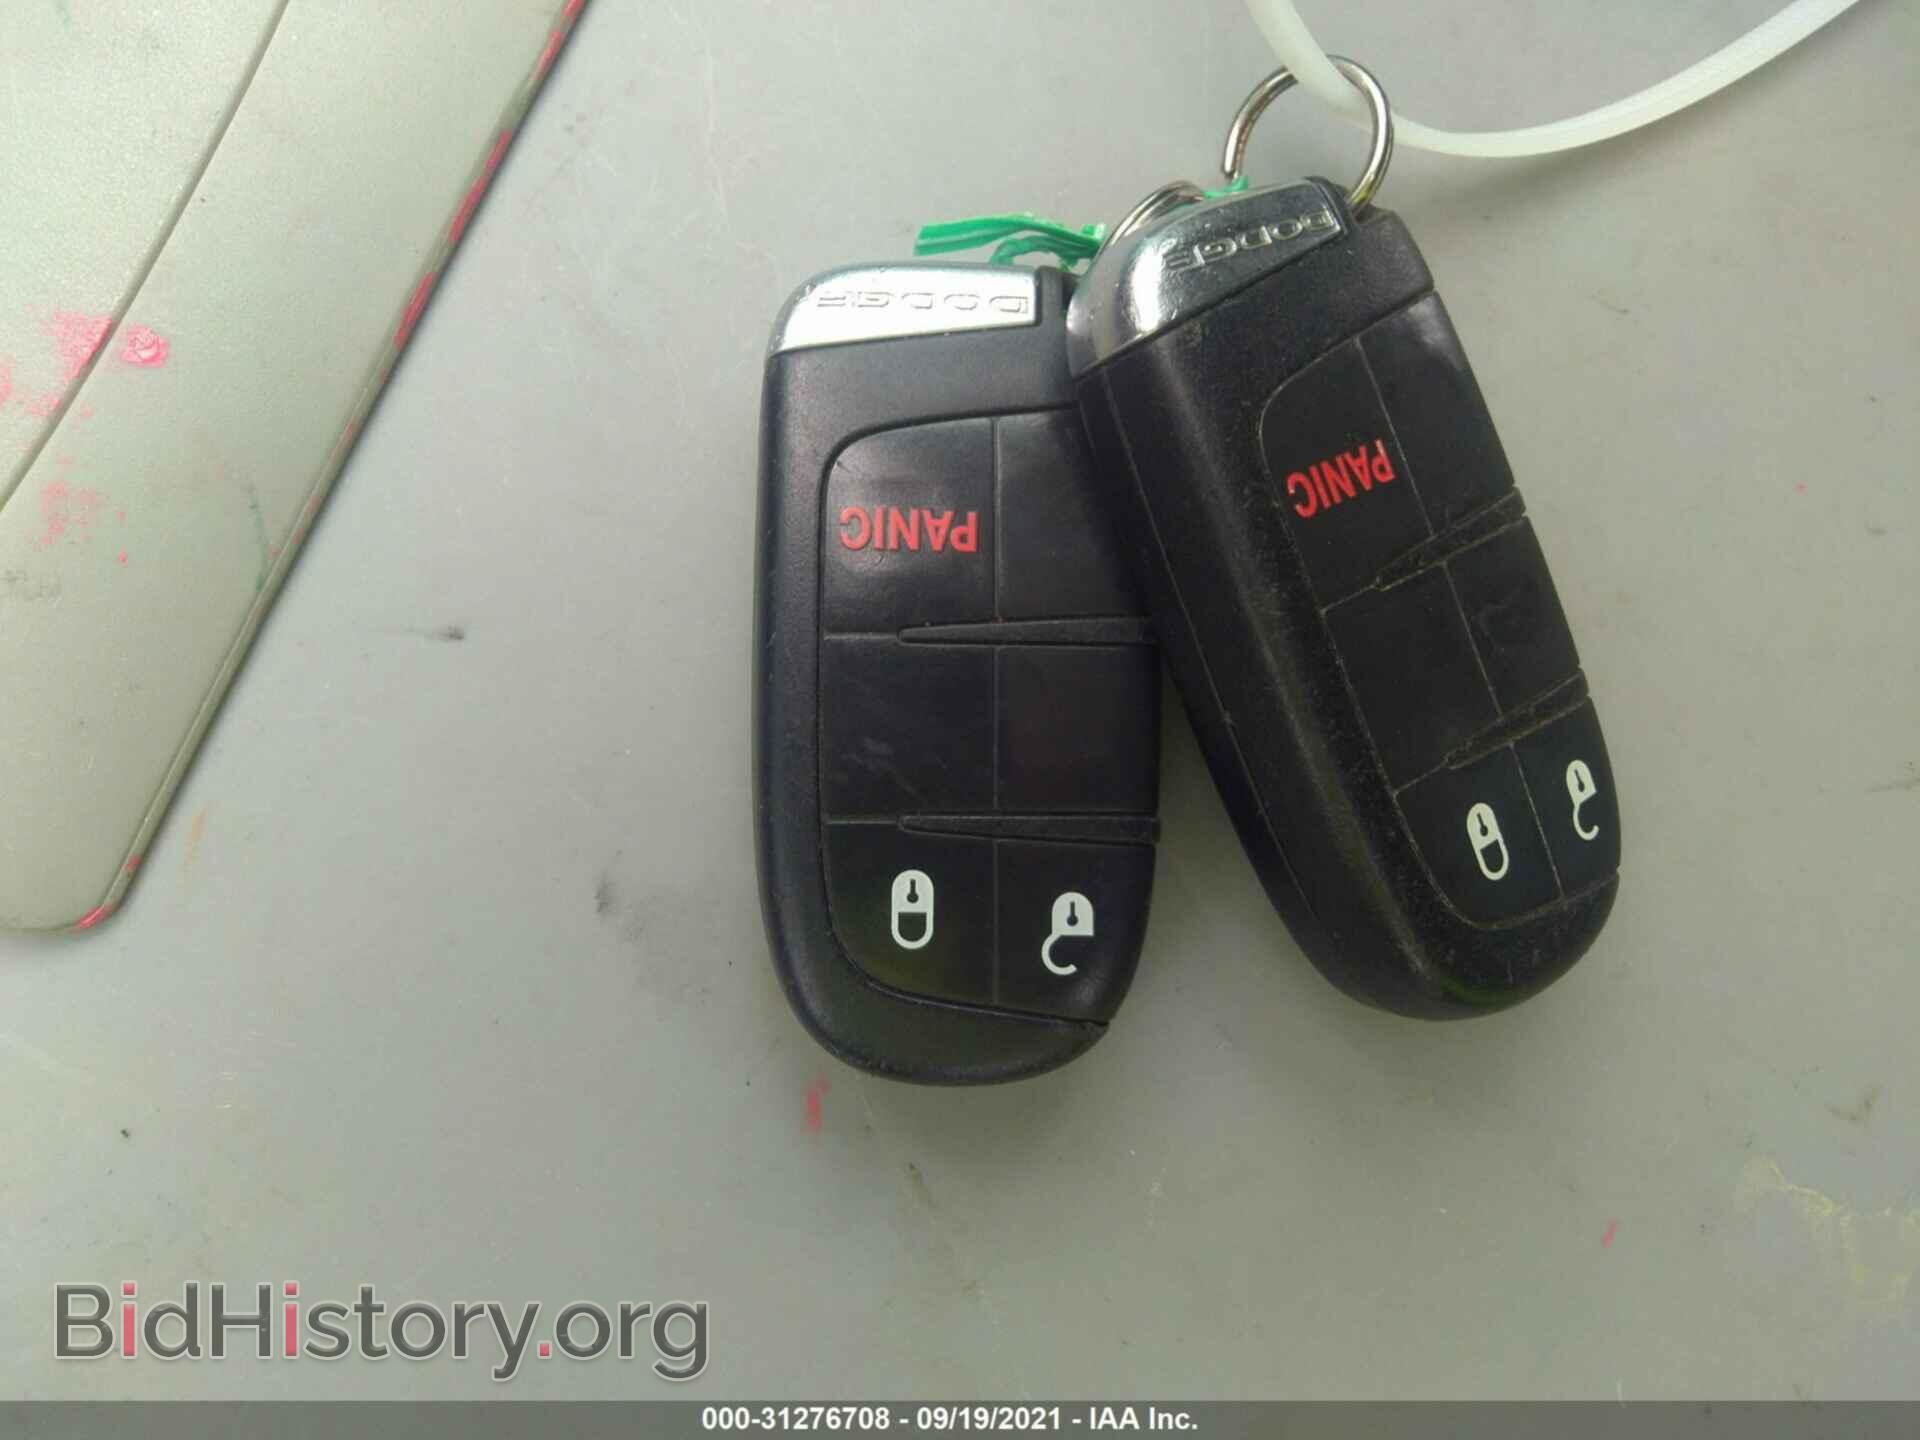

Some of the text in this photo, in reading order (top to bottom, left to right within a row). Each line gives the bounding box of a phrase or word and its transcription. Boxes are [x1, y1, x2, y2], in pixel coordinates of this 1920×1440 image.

[1161, 206, 1342, 272] DODGE
[1287, 438, 1396, 518] PANIC
[840, 505, 978, 553] PANIC
